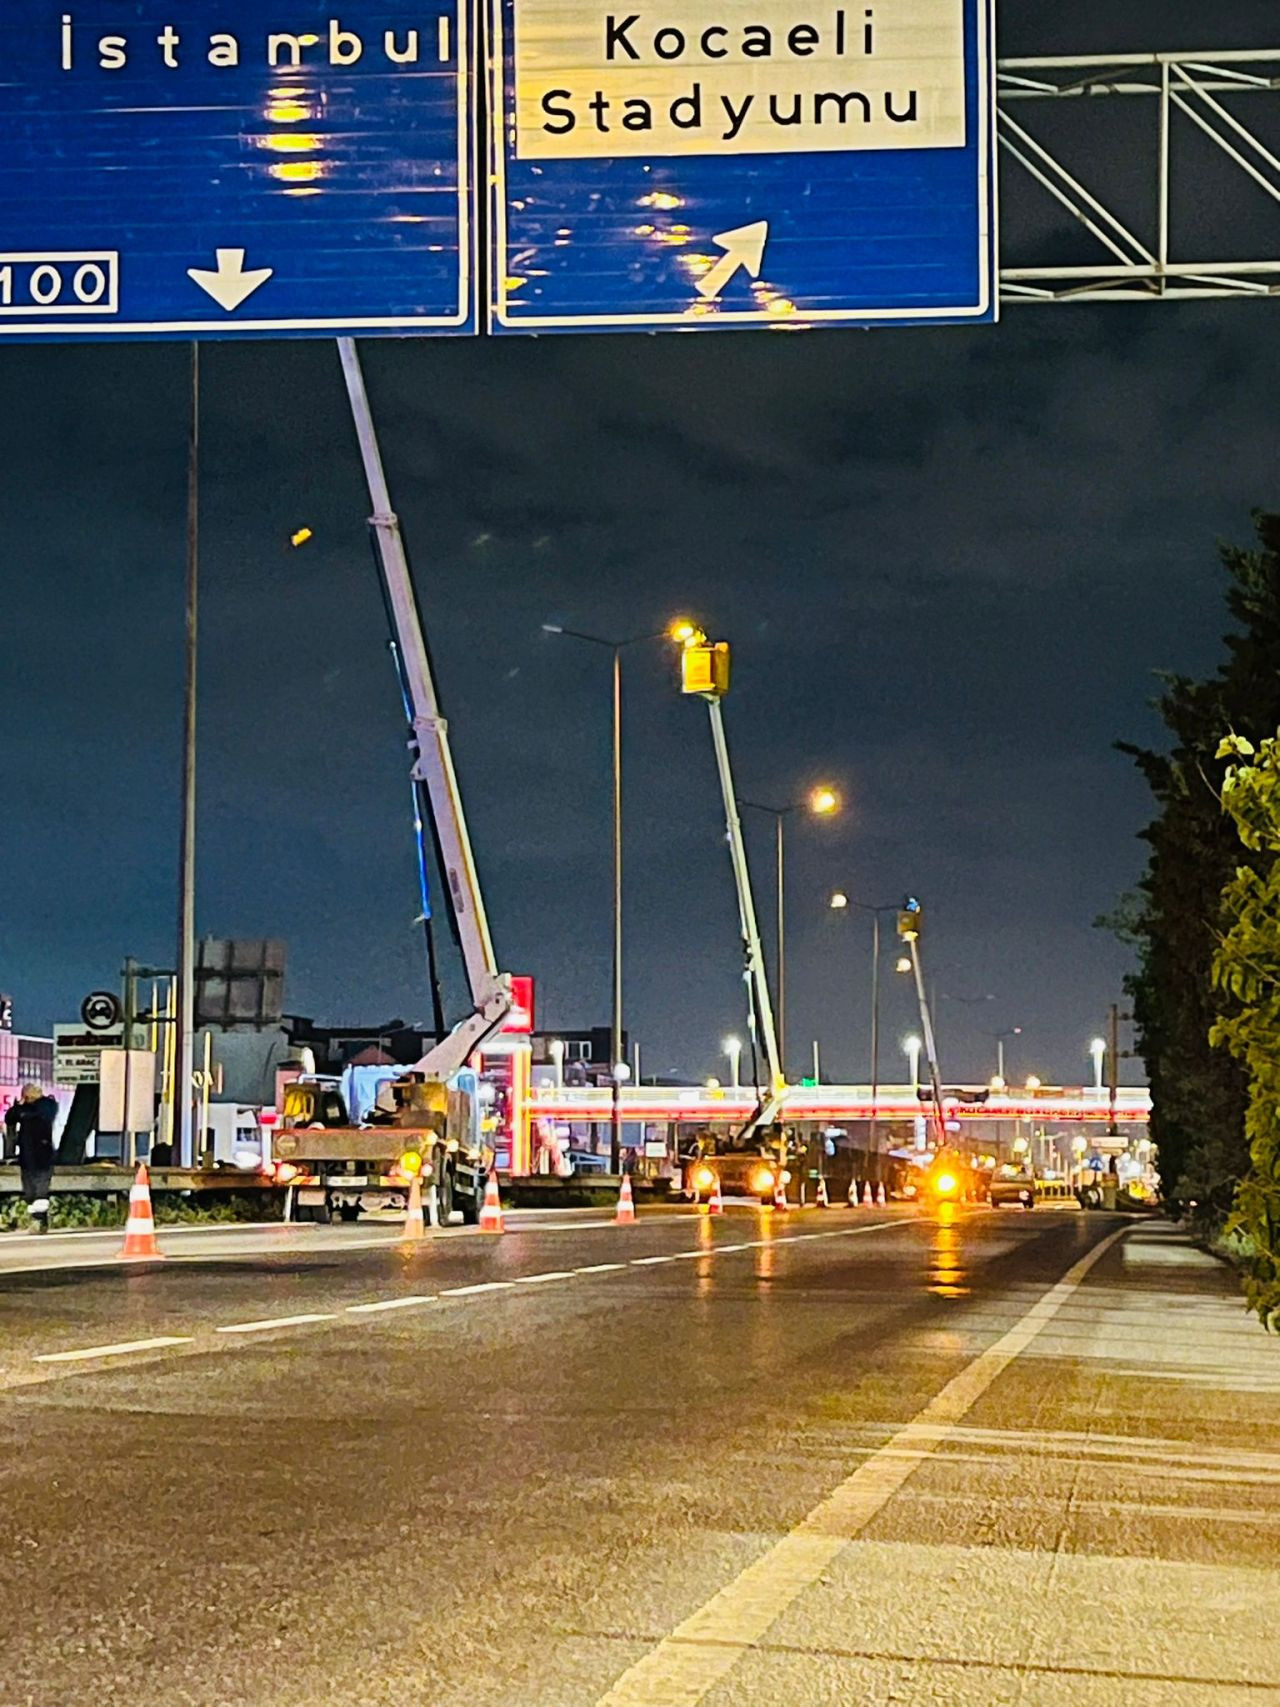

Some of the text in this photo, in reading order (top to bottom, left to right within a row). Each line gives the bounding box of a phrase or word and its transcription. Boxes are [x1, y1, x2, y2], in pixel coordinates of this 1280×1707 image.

[61, 14, 449, 71] İstanbul
[605, 9, 874, 61] Kocaeli
[541, 83, 918, 140] Stadyumu
[0, 262, 106, 305] 100
